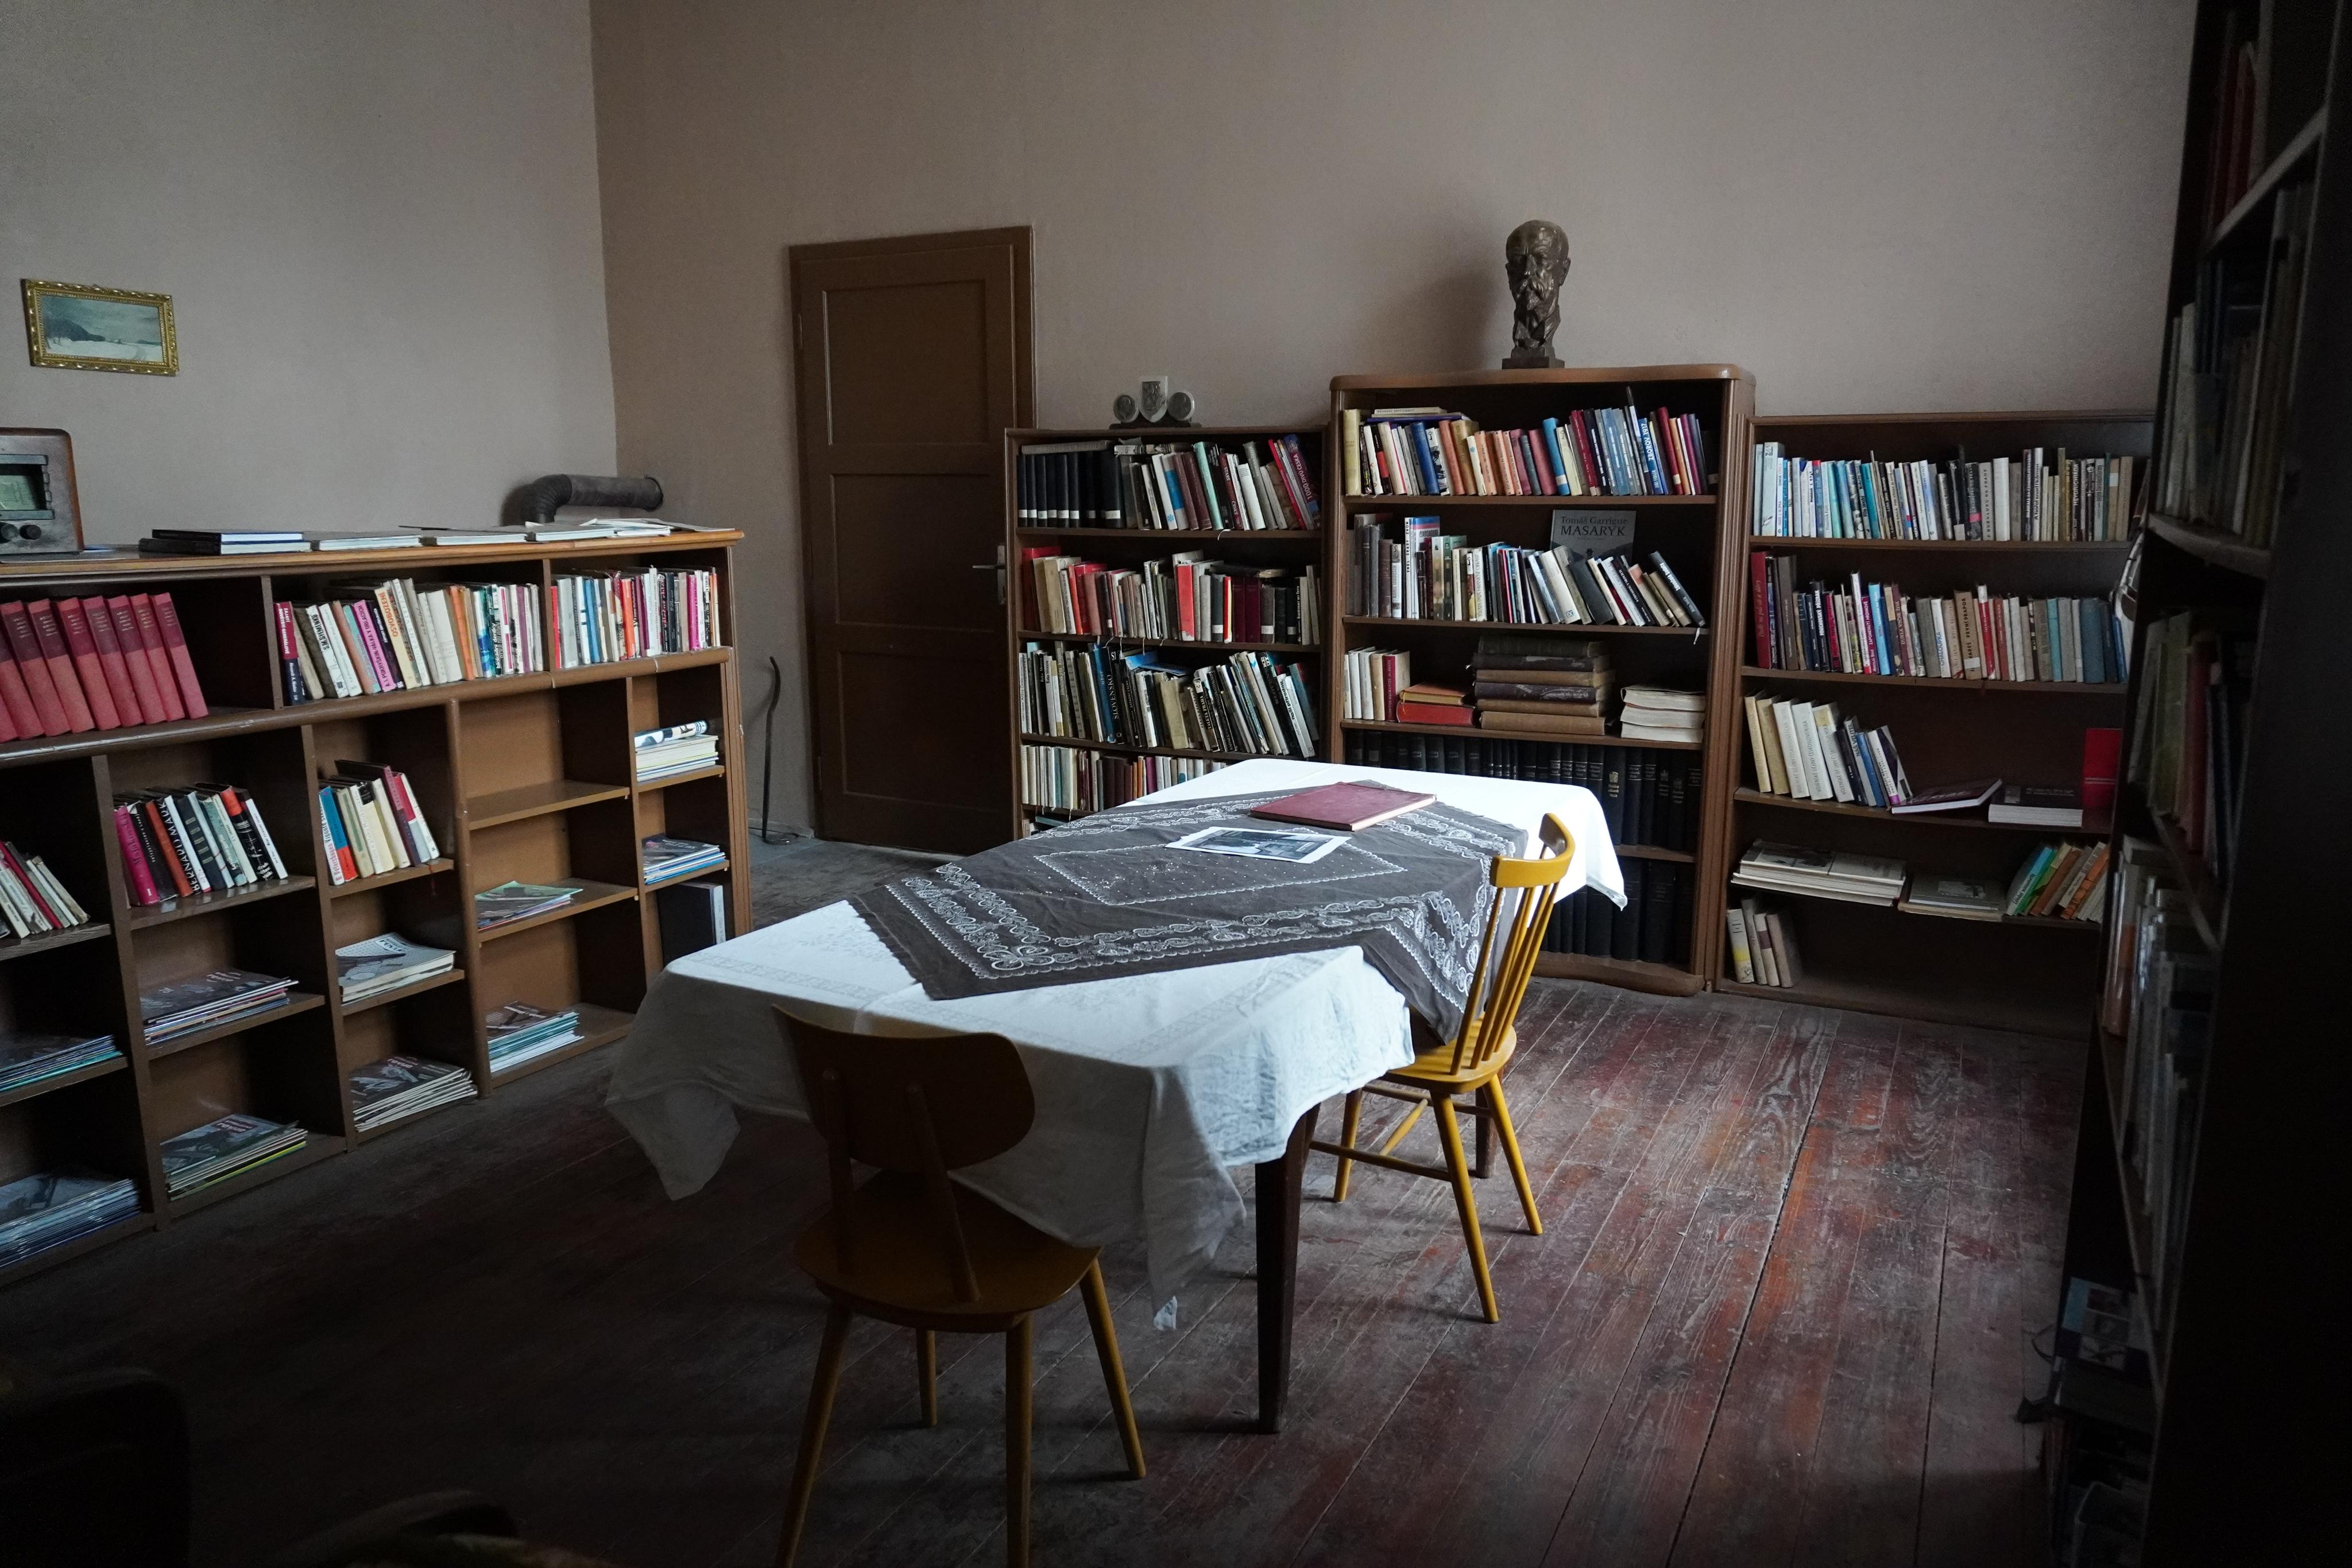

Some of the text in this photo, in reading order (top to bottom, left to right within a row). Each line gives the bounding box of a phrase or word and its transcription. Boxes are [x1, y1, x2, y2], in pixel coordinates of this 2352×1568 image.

[1641, 422, 1654, 460] ZBOROV 1917
[1291, 453, 1313, 500] 1000 DIVŮ ČESKA
[1561, 516, 1628, 525] Tomáš Garrigue
[1561, 525, 1626, 536] MASARYK
[377, 591, 399, 638] OSVOBOZENÍ
[1815, 609, 1824, 636] MNICHOVSKÝ
[1057, 667, 1066, 695] Jihočeským
[1105, 673, 1119, 719] SLOVENSKO
[1198, 695, 1207, 711] PRAHA
[1847, 723, 1860, 757] NÁŠ VELITEL
[1802, 720, 1821, 793] VOJENSKÉ DĚJINY ČESKOSLOVENSKA
[1832, 759, 1840, 774] DĚJINY
[1836, 775, 1846, 795] VOJENSKÉ
[157, 800, 179, 837] MARK
